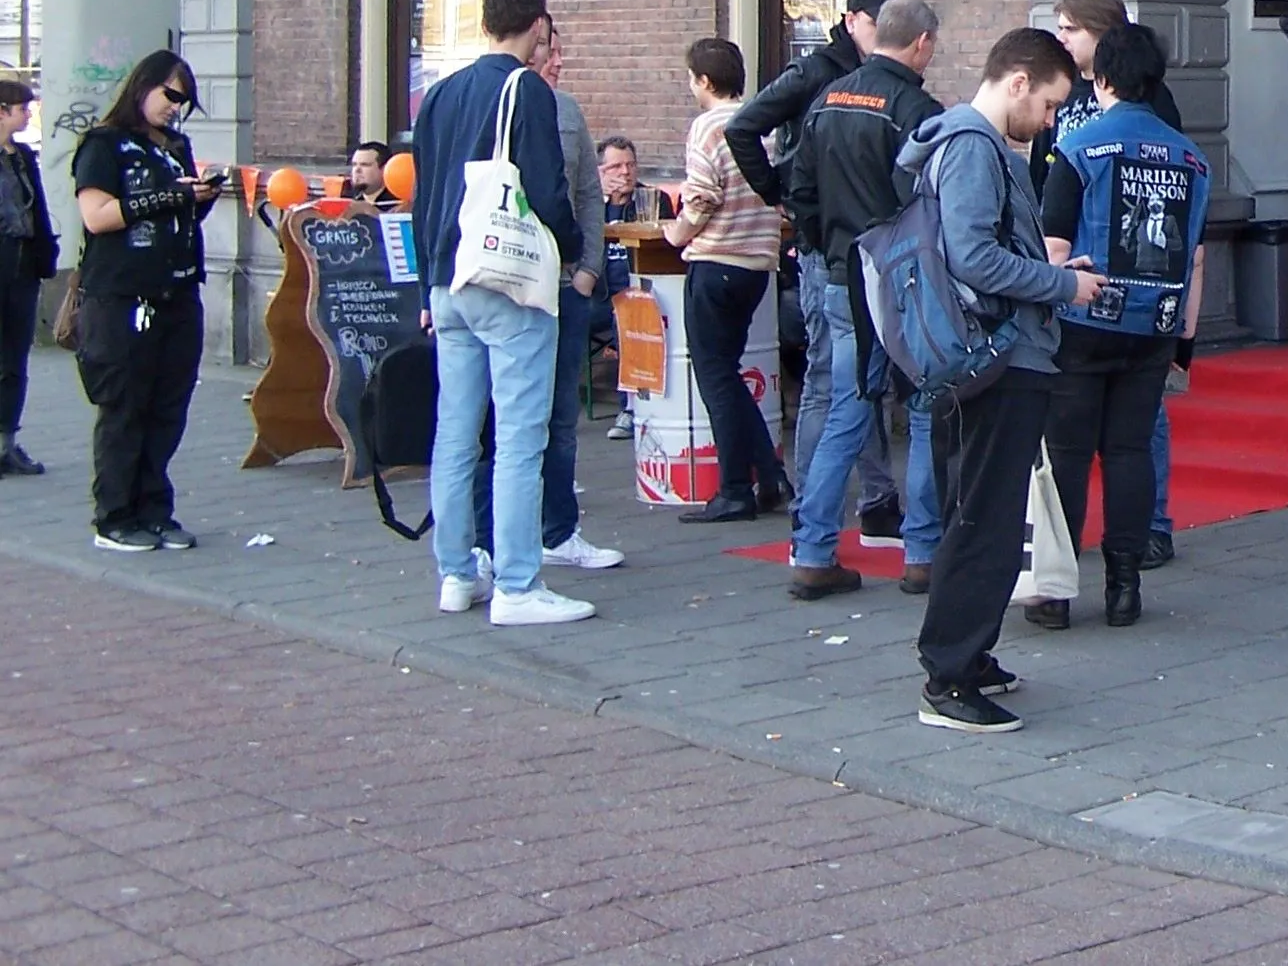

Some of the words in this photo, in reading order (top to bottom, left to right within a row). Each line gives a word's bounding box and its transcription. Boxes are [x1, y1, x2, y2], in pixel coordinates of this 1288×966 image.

[1119, 165, 1189, 186] MARILYN
[498, 183, 513, 212] I
[1121, 180, 1187, 202] MANSON
